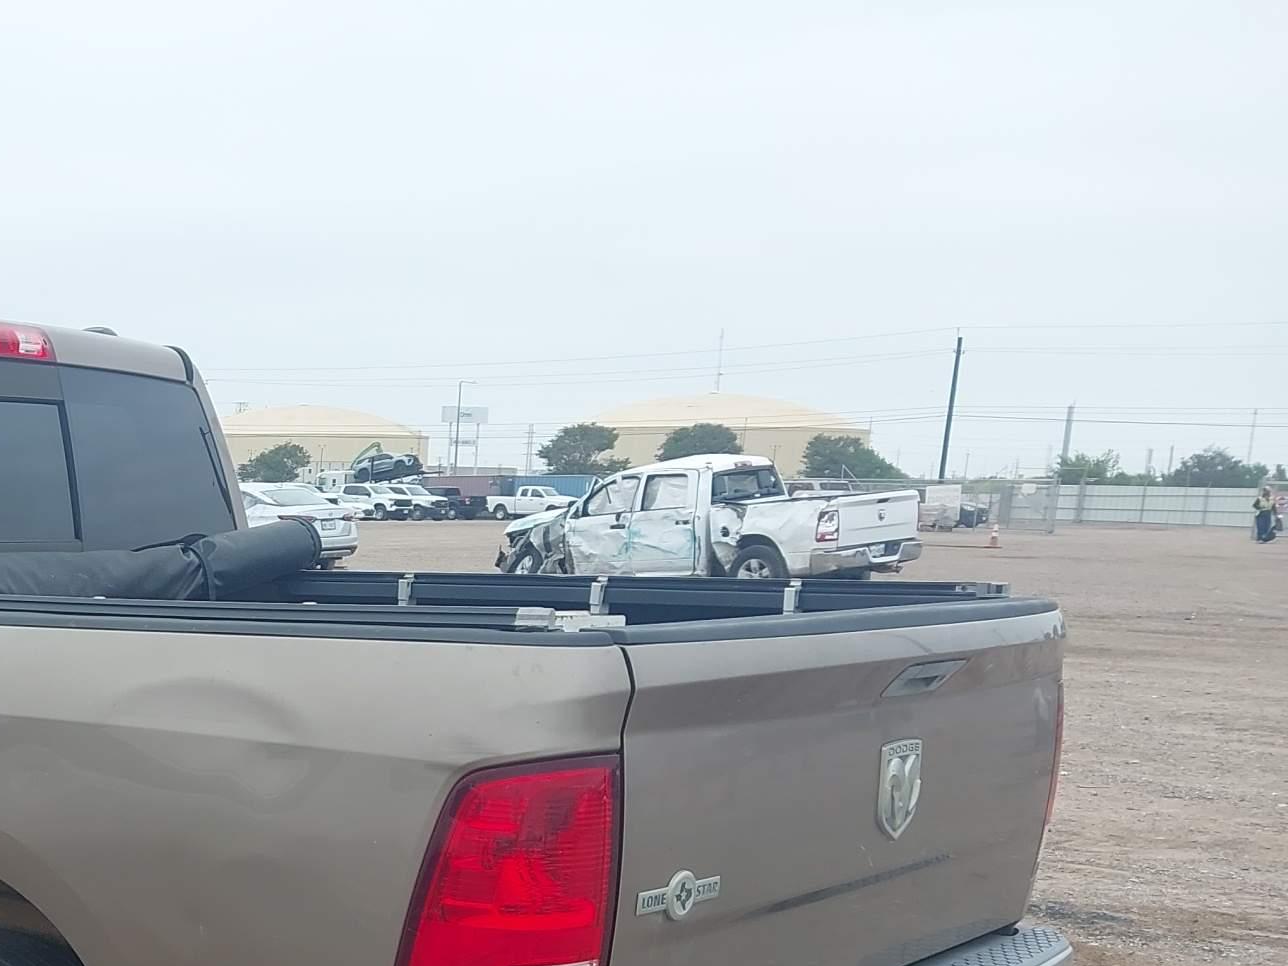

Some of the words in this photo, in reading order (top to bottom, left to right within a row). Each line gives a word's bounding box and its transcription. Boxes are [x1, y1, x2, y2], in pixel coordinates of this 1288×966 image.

[887, 742, 920, 757] DODGE
[641, 892, 667, 909] LONE
[695, 881, 719, 898] STAR
